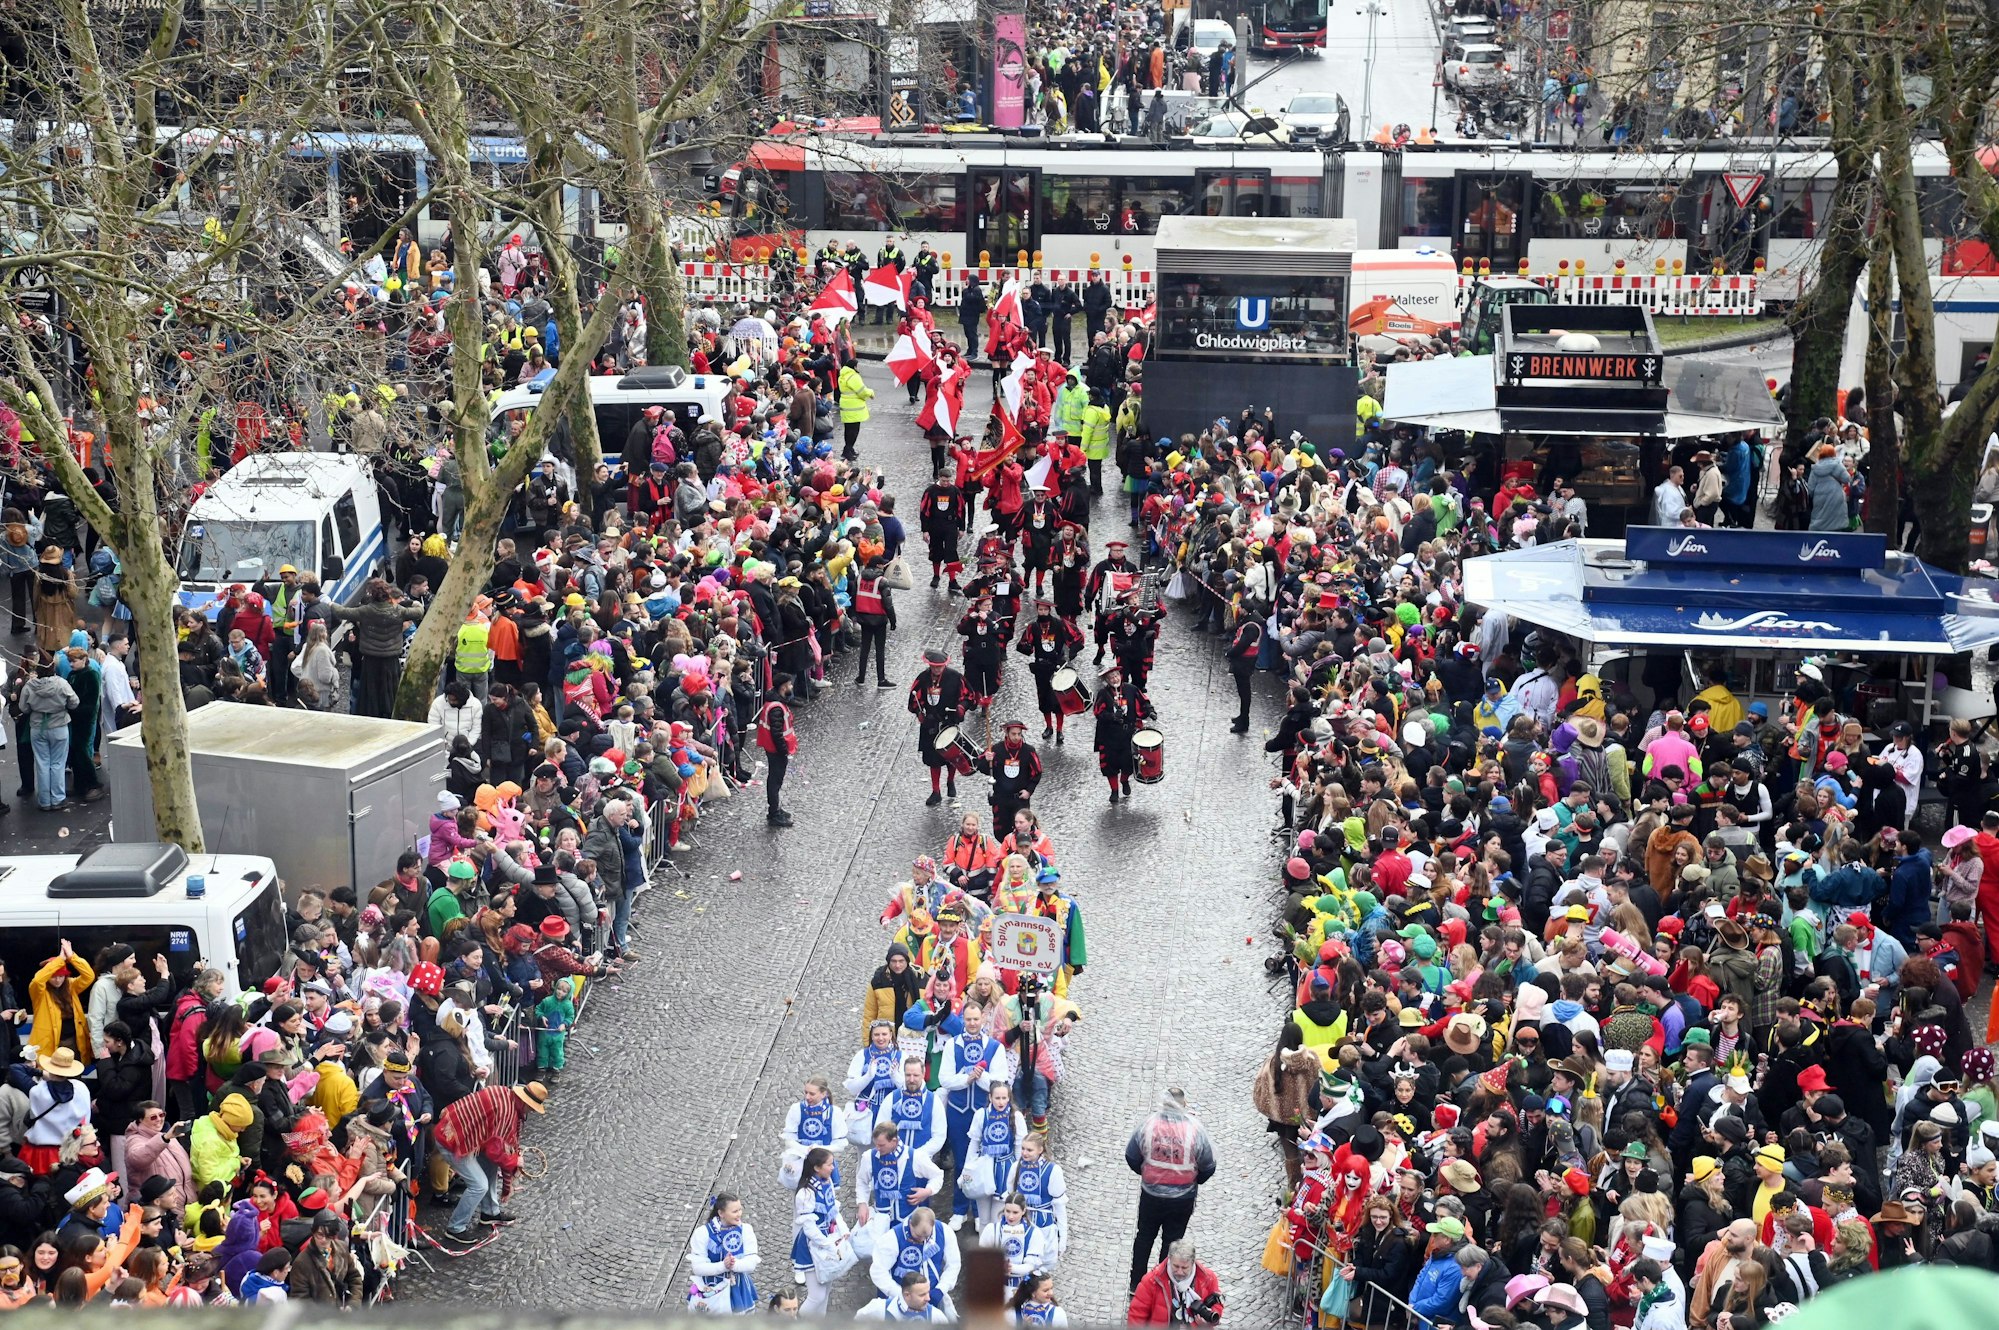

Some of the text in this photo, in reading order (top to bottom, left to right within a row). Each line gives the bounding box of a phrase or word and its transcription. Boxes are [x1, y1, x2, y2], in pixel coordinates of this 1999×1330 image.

[1240, 299, 1266, 327] U
[1196, 333, 1307, 352] Chlodwigplatz
[1530, 356, 1637, 378] BRENNWERK
[1666, 535, 1708, 557] Sion
[1798, 539, 1841, 562] Sion
[1690, 611, 1842, 631] Sion
[998, 920, 1056, 953] Spillmannsgasser
[1000, 955, 1053, 970] Junge e.V.
